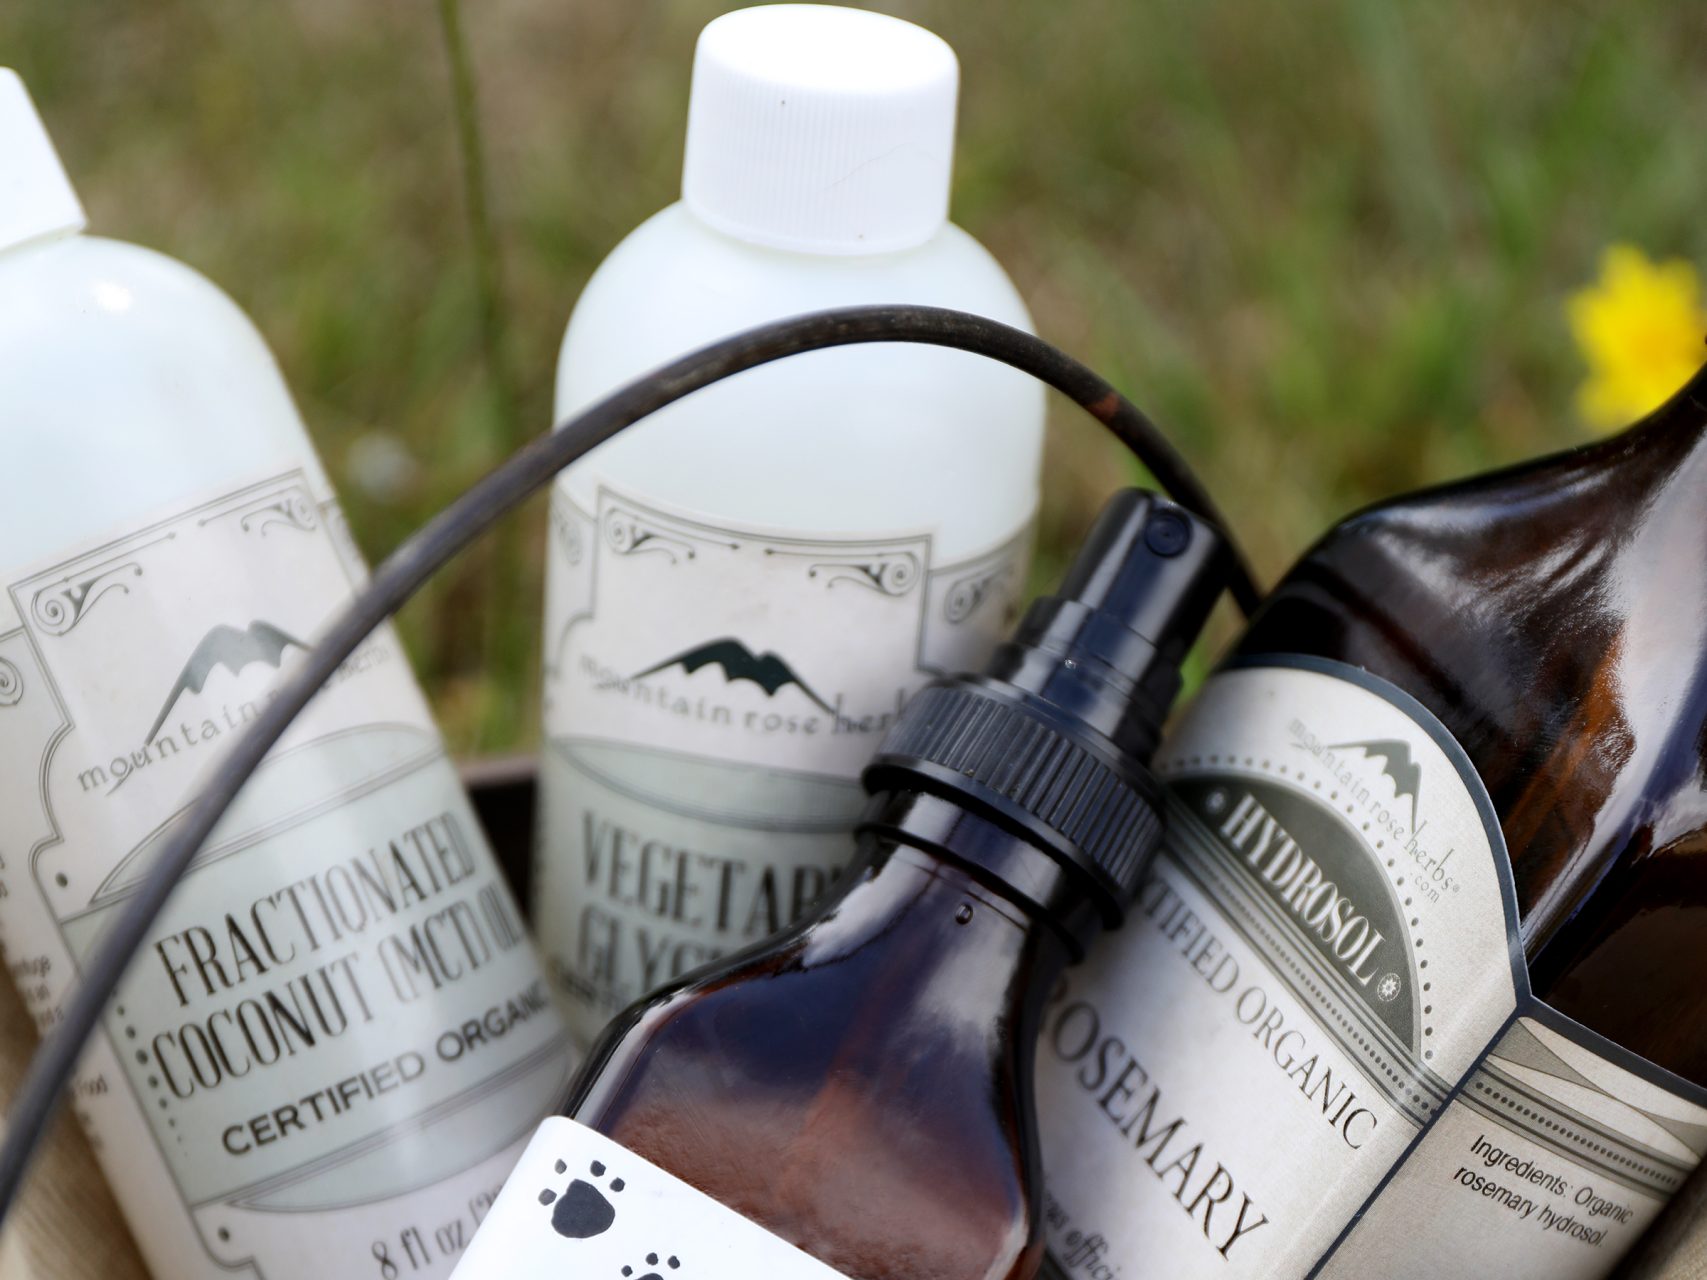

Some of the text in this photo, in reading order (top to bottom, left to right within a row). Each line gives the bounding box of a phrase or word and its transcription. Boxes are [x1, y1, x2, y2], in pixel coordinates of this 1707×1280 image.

[153, 811, 475, 1008] FRACTIONATED
[1221, 793, 1386, 987] HYDROSOL
[151, 957, 374, 1100] COCONUT
[1145, 876, 1378, 1150] TIFIED ORGANIC
[221, 1050, 427, 1156] CERTIFIED
[1050, 982, 1270, 1262] OSEMARY
[1453, 1166, 1540, 1220] rosemary
[1470, 1134, 1635, 1226] Ingredients: Organic
[371, 1240, 398, 1280] 8
[400, 1226, 432, 1270] fl
